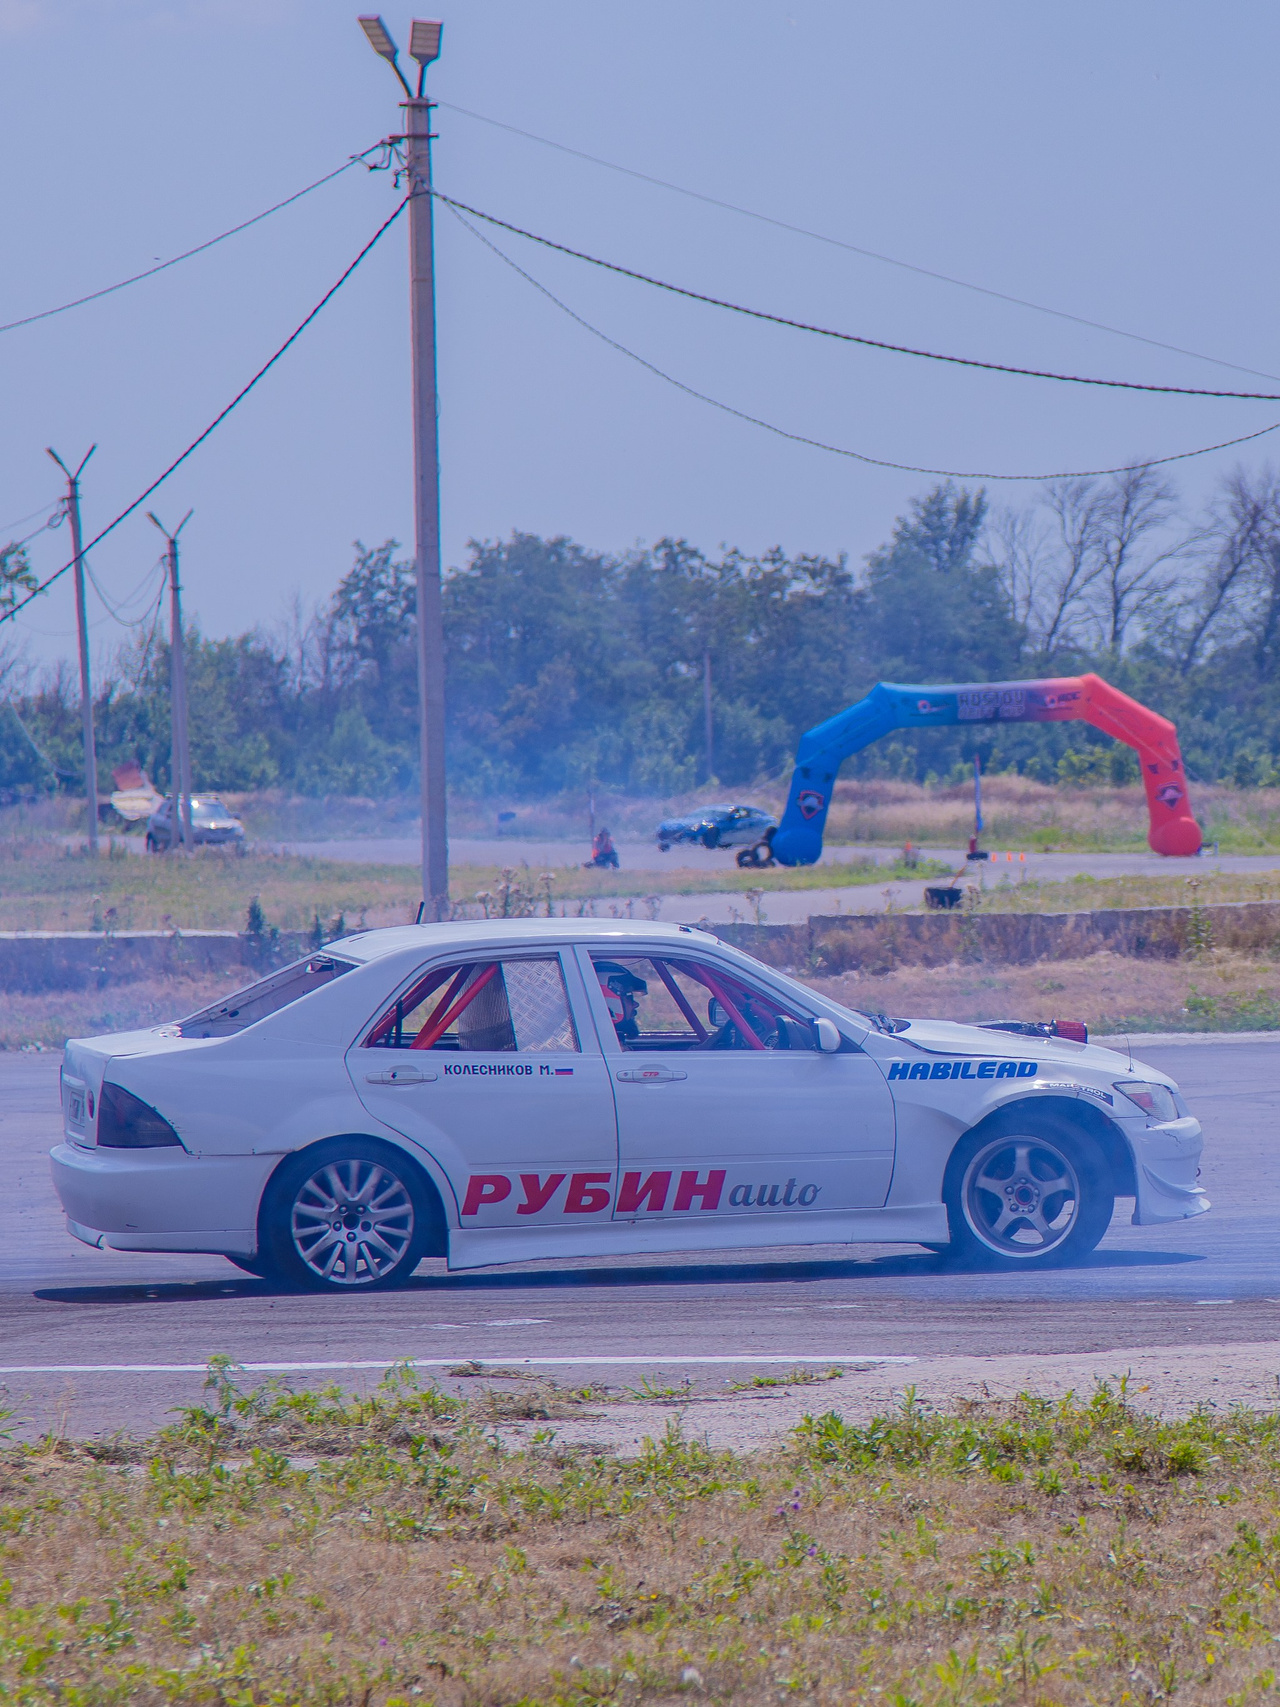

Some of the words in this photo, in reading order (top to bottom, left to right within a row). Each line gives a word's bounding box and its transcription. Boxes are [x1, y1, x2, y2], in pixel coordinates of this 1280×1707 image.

[444, 1064, 533, 1075] КОЛЕСНИКОВ
[539, 1064, 554, 1075] М.
[887, 1061, 1038, 1080] HABILEAD
[461, 1169, 728, 1216] РУБИН
[728, 1178, 824, 1207] auto
